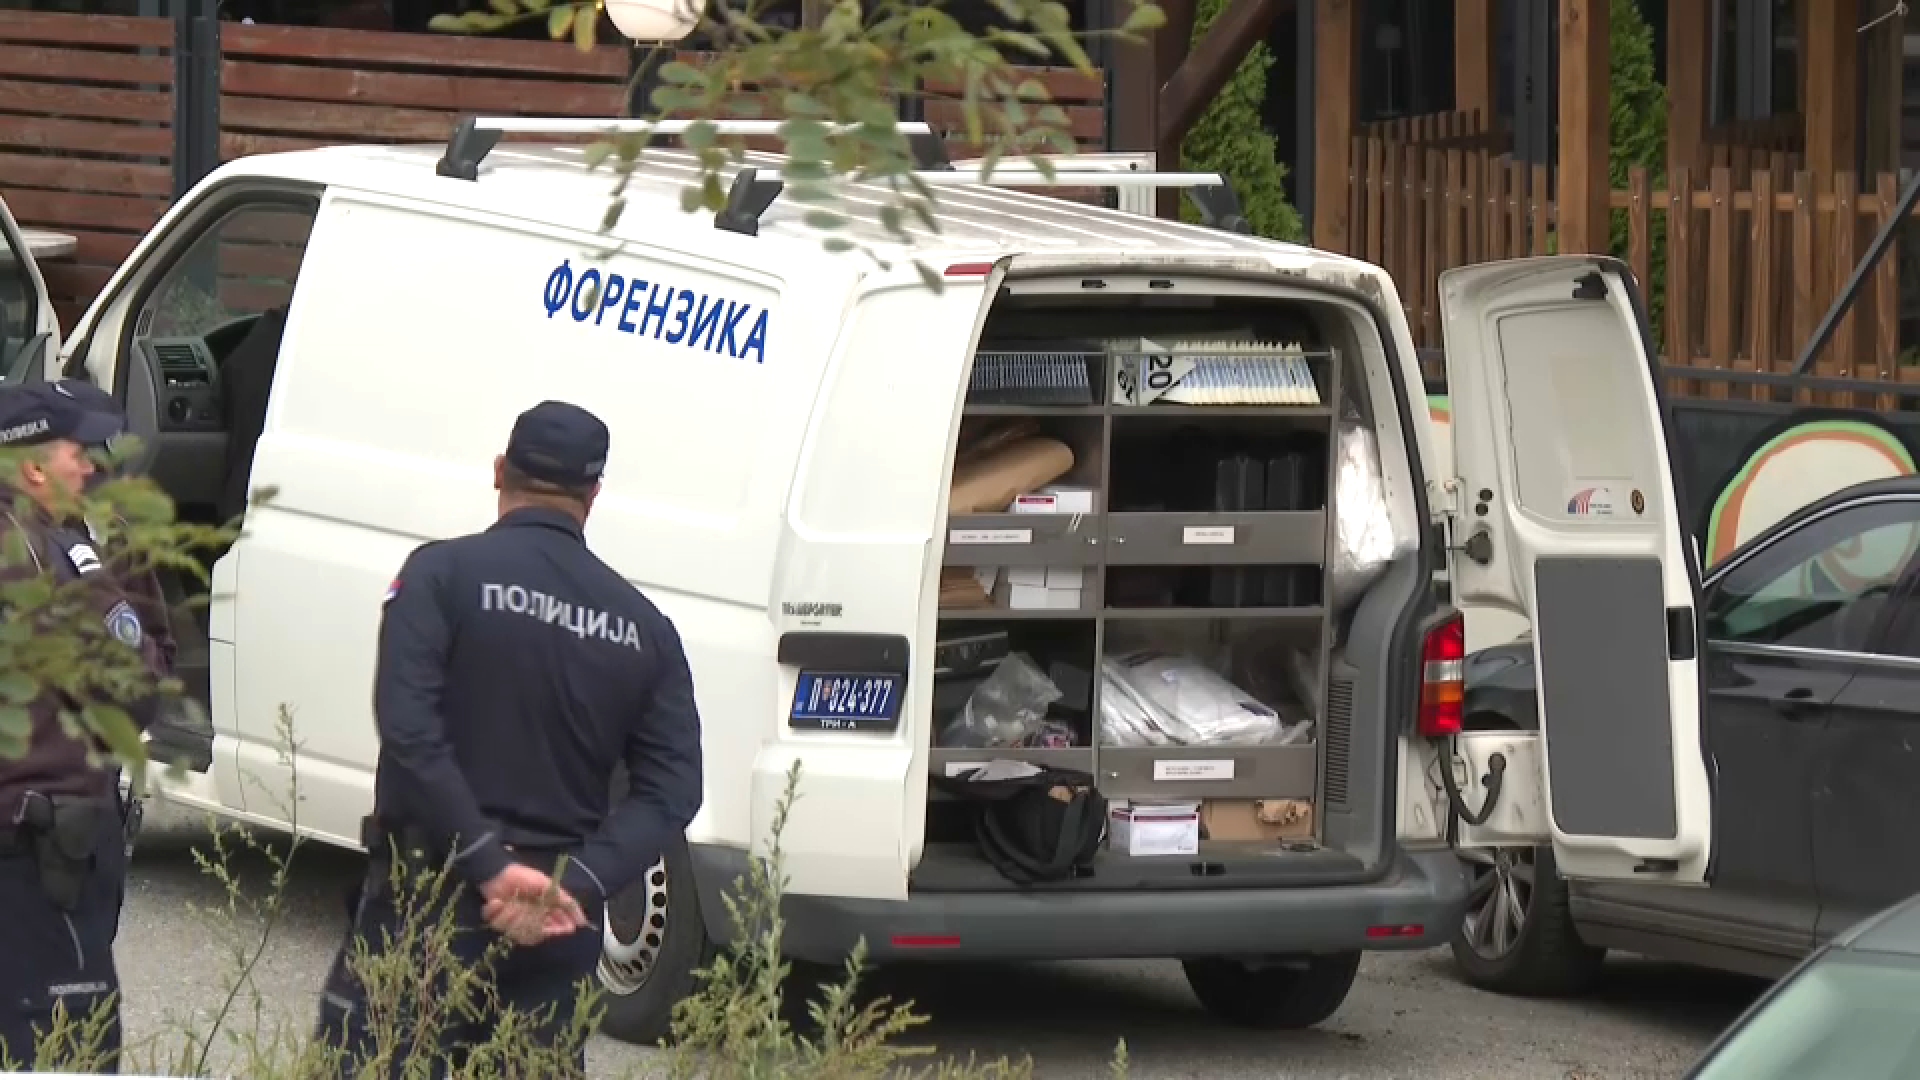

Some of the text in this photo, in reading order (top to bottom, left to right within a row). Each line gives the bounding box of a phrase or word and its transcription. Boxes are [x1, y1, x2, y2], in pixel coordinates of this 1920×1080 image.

[543, 258, 768, 364] ФОРЕНЗИКА
[1149, 354, 1173, 389] 20
[481, 583, 641, 651] ПОЛИЦИЈА
